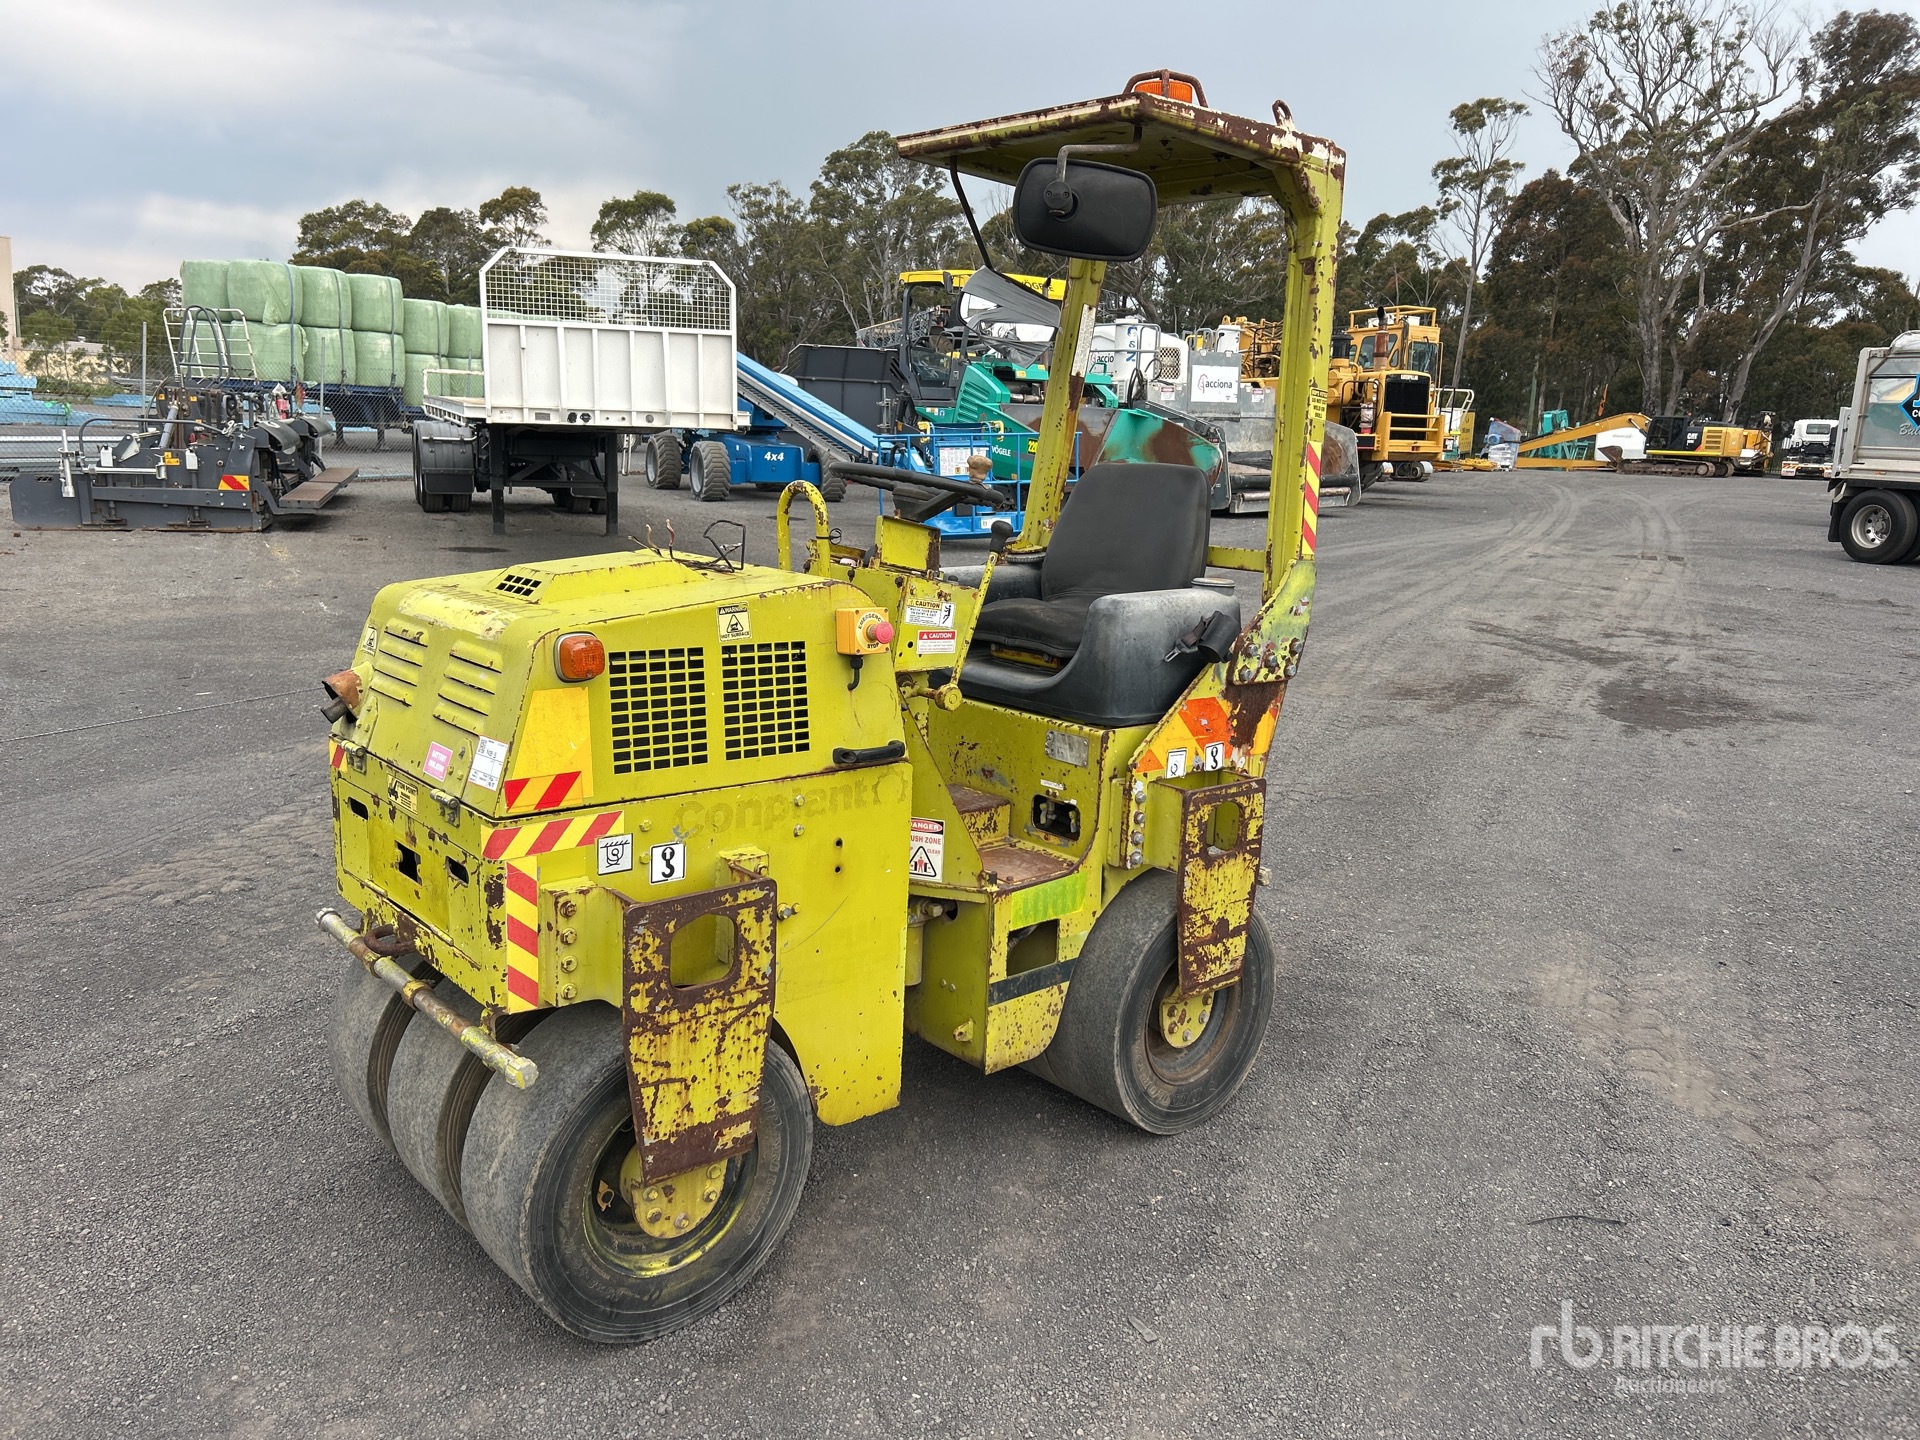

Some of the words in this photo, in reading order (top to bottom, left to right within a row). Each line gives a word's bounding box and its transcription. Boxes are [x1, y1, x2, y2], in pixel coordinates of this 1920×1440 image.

[1096, 352, 1114, 363] accio
[1205, 379, 1233, 389] acciona
[992, 445, 1011, 457] VÖGELE
[764, 452, 785, 462] 4x4
[675, 777, 867, 836] Conplant
[910, 821, 939, 830] ANGER
[925, 837, 942, 845] ZONE
